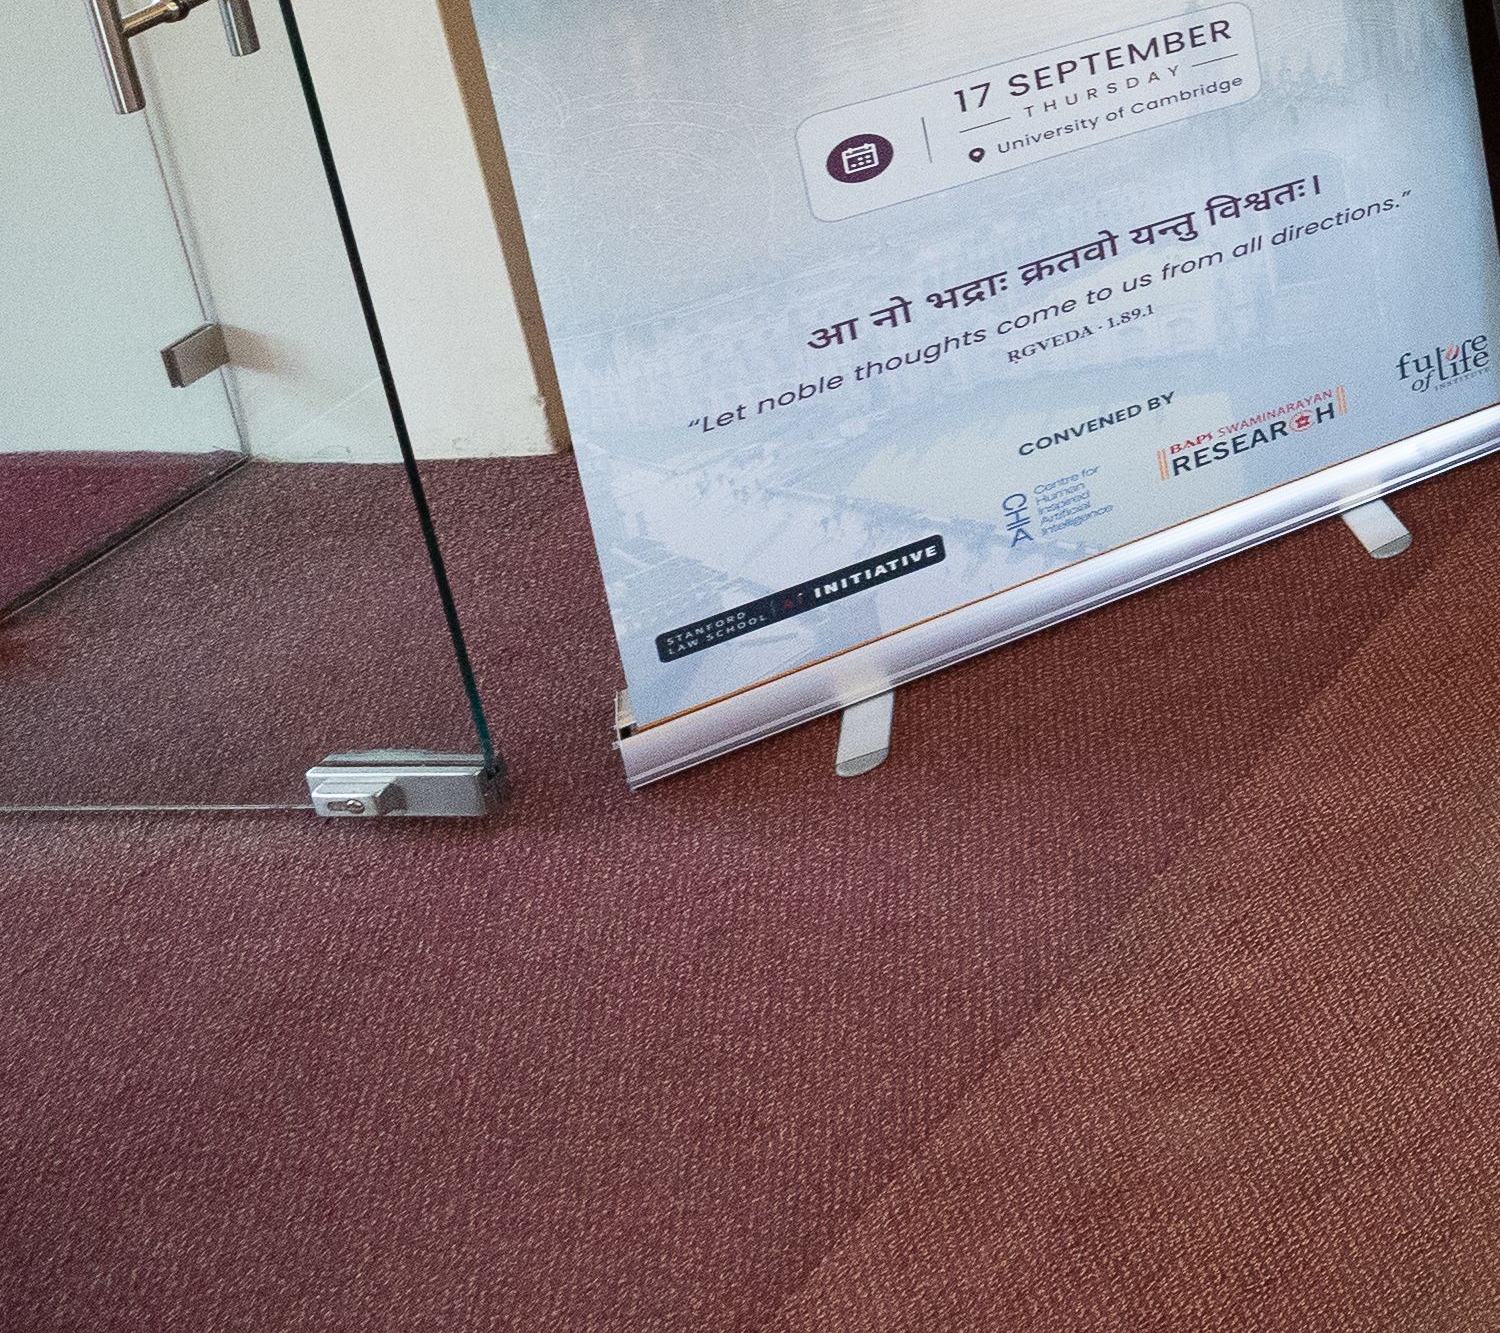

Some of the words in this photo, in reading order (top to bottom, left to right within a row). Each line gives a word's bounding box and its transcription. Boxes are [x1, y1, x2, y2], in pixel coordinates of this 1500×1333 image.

[954, 82, 991, 115] 17
[1009, 19, 1232, 99] SEPTEMBER
[1023, 64, 1181, 119] THURSDAY
[997, 112, 1099, 156] University
[1105, 105, 1126, 124] of
[1131, 75, 1244, 119] Cambridge
[759, 374, 845, 415] noble
[853, 326, 988, 389] thoughts
[996, 300, 1077, 335] come
[1086, 281, 1113, 305] to
[1121, 273, 1153, 293] us
[1161, 247, 1225, 284] from
[1232, 235, 1263, 259] all
[806, 314, 860, 353] आ
[870, 294, 914, 330] नो
[1106, 304, 1155, 330] 1.89.1
[1411, 369, 1436, 393] of
[1018, 403, 1142, 456] CONVENED
[1147, 390, 1175, 411] BY
[1169, 432, 1213, 455] BAPS
[1217, 388, 1333, 437] SWAMINARAYAN
[1034, 474, 1078, 494] Centre
[1081, 465, 1100, 478] for
[1036, 483, 1085, 506] Human
[1039, 490, 1091, 515] Inspired
[1002, 493, 1034, 548] CHIA
[1041, 504, 1114, 537] Intelligence
[813, 545, 938, 599] INITIATIVE
[667, 611, 747, 647] STANFORD
[669, 639, 699, 655] LAW
[706, 614, 767, 642] SCHOOL
